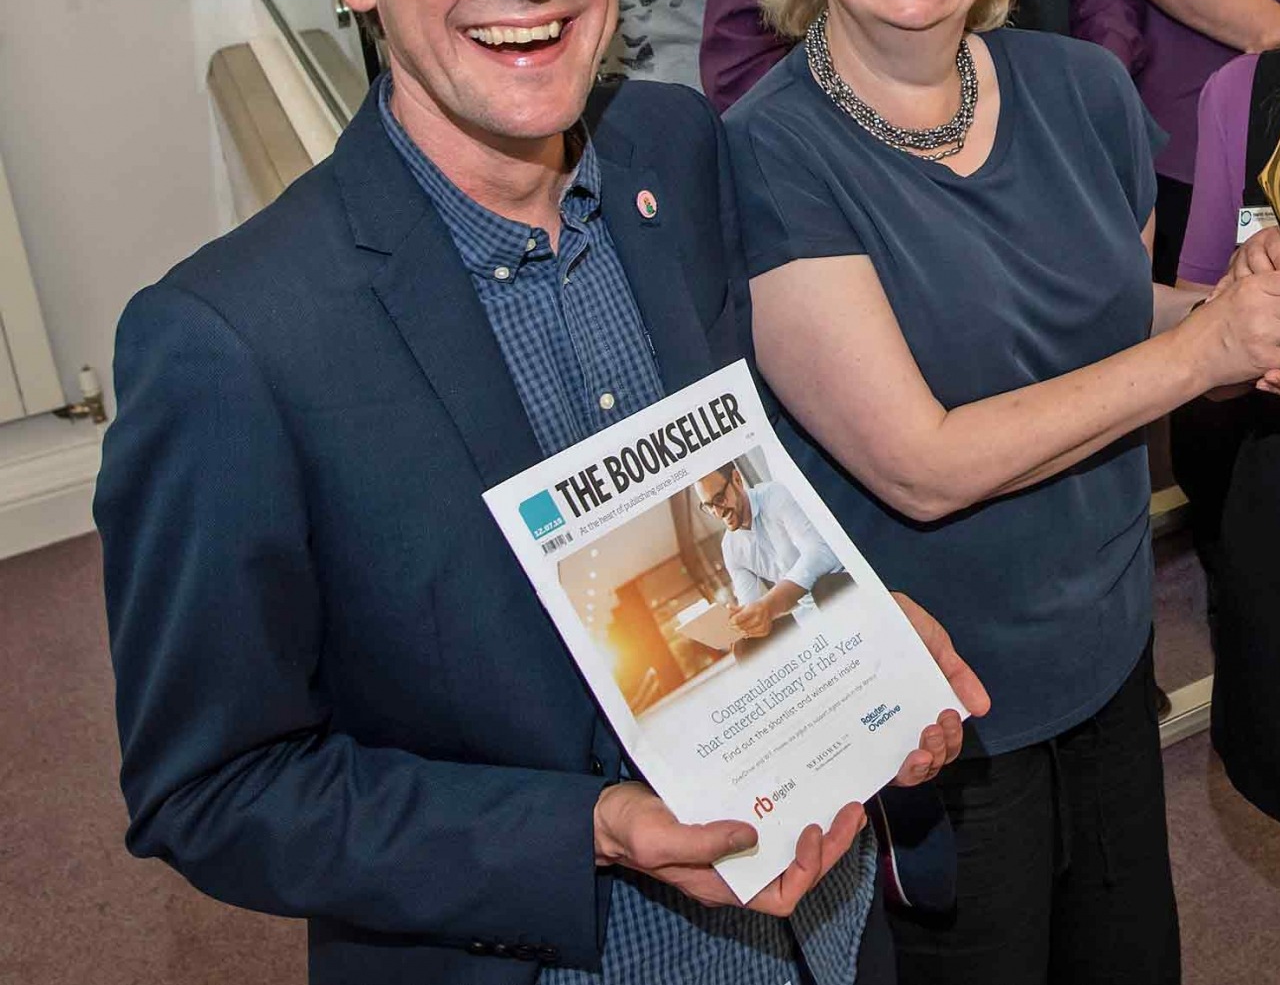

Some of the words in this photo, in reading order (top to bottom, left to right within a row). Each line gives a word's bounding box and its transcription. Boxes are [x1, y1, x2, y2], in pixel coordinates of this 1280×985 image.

[555, 463, 613, 518] THE
[603, 392, 747, 494] BOOKSELLER
[586, 518, 599, 530] the
[597, 508, 617, 524] heart
[622, 486, 657, 511] publishing
[696, 735, 724, 759] that
[723, 708, 764, 740] entered
[764, 679, 806, 711] Library
[804, 664, 819, 683] of
[816, 652, 836, 672] the
[835, 631, 864, 655] Year
[711, 657, 799, 725] Congratulations
[799, 649, 813, 666] to
[813, 634, 829, 659] all
[722, 748, 742, 763] Find
[741, 737, 756, 750] out
[755, 726, 769, 740] the
[768, 707, 798, 732] shortlist
[799, 696, 813, 712] and
[812, 677, 839, 697] winners
[839, 658, 861, 679] inside
[860, 703, 888, 726] Rakuten
[868, 704, 901, 732] OverDrive
[753, 796, 774, 820] rb
[772, 779, 797, 803] digital
